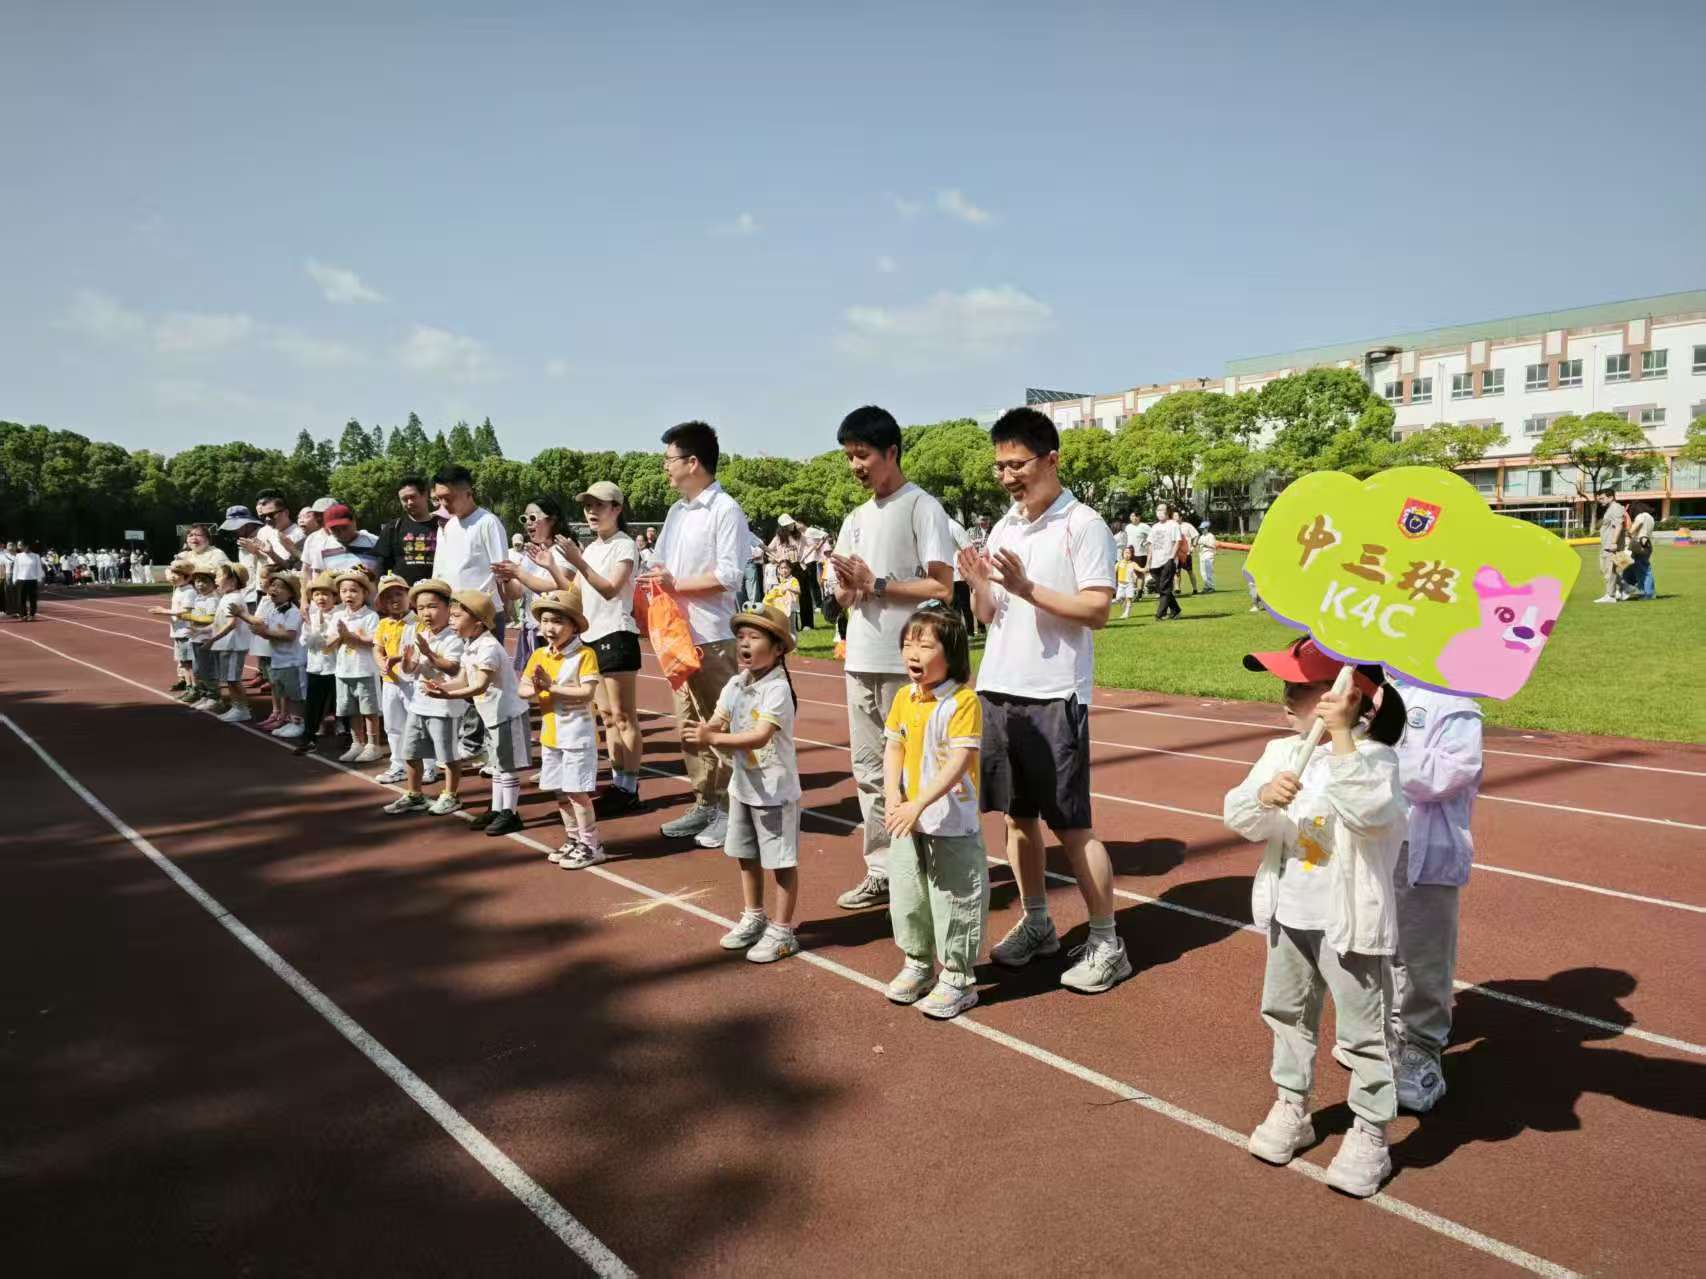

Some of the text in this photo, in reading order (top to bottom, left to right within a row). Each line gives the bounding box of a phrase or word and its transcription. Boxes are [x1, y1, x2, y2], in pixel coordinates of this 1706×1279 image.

[1296, 514, 1459, 603] 中三班
[1319, 580, 1415, 638] K4C
